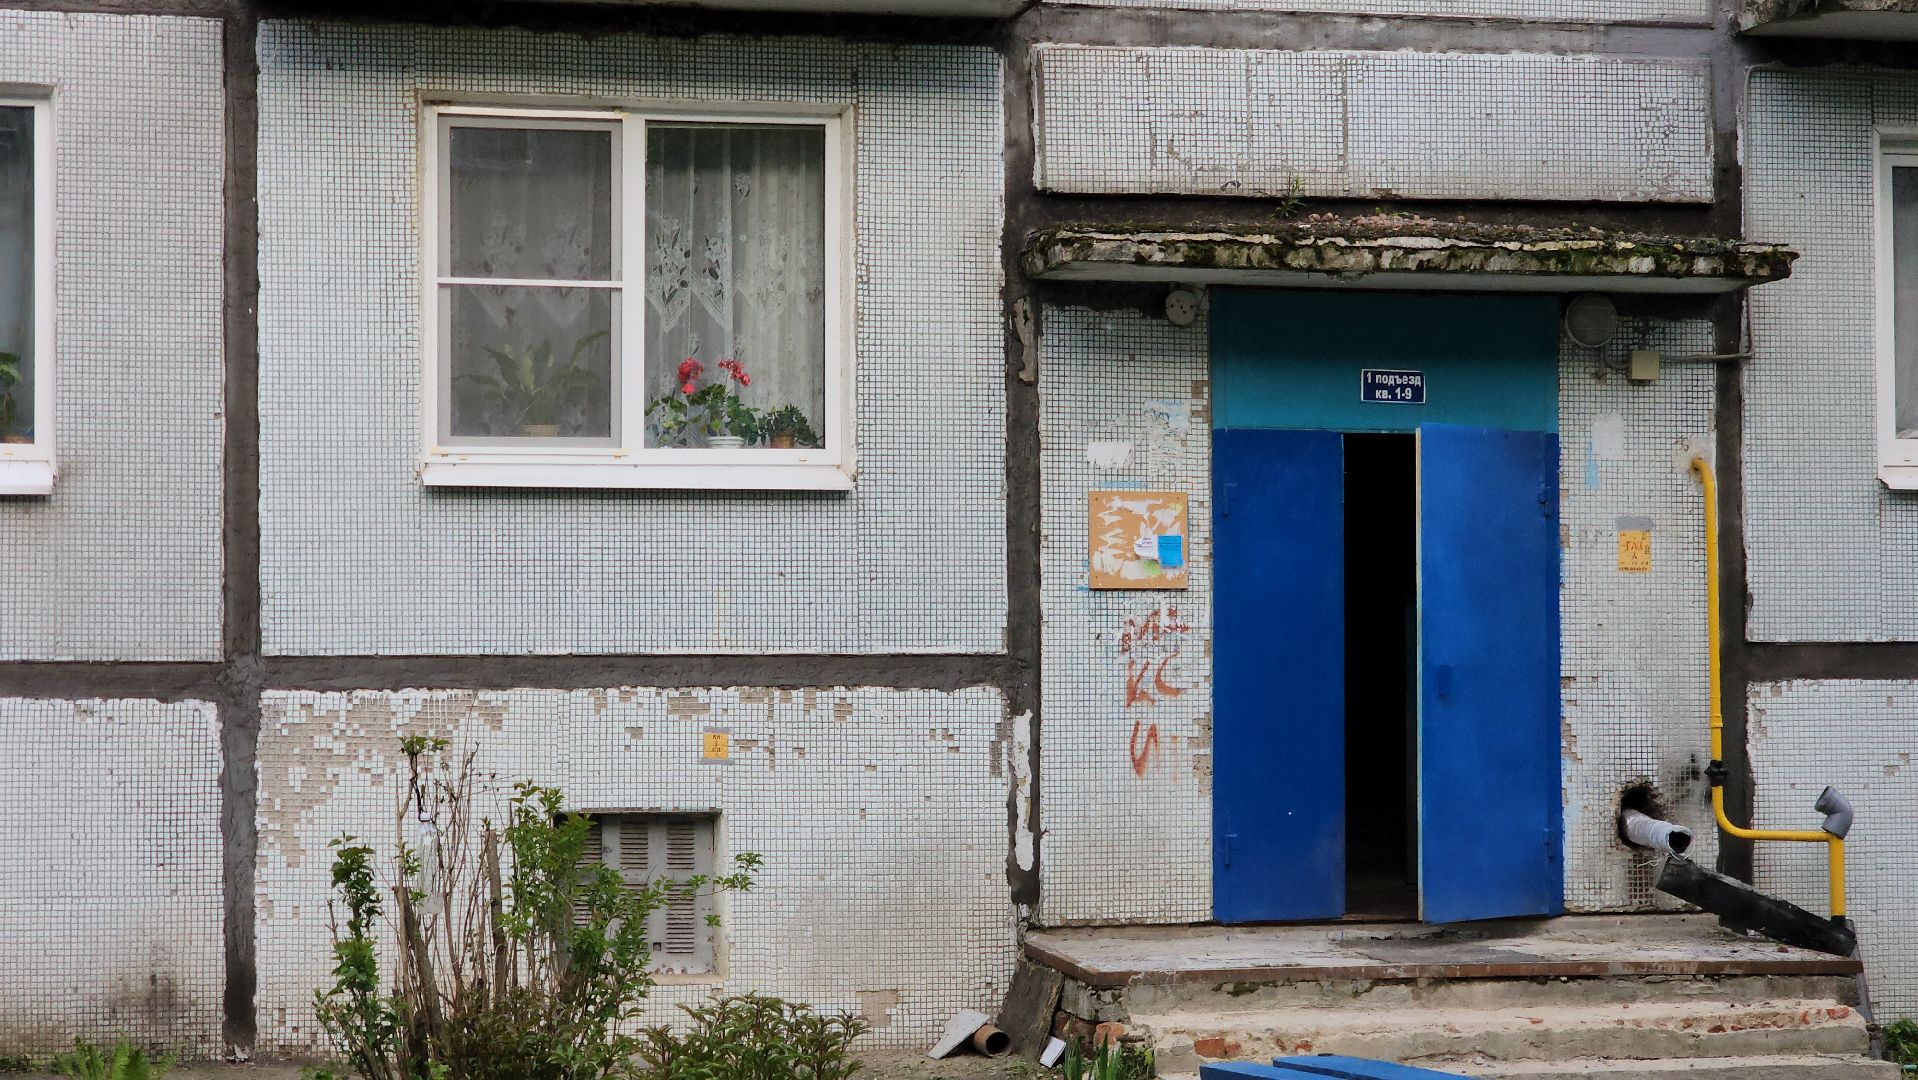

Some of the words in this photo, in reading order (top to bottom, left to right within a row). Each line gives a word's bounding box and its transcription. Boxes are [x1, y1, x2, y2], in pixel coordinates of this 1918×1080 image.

[1366, 371, 1372, 384] 1
[1375, 374, 1422, 387] подъезд
[1375, 389, 1392, 399] кв.
[1395, 386, 1413, 400] 1-9
